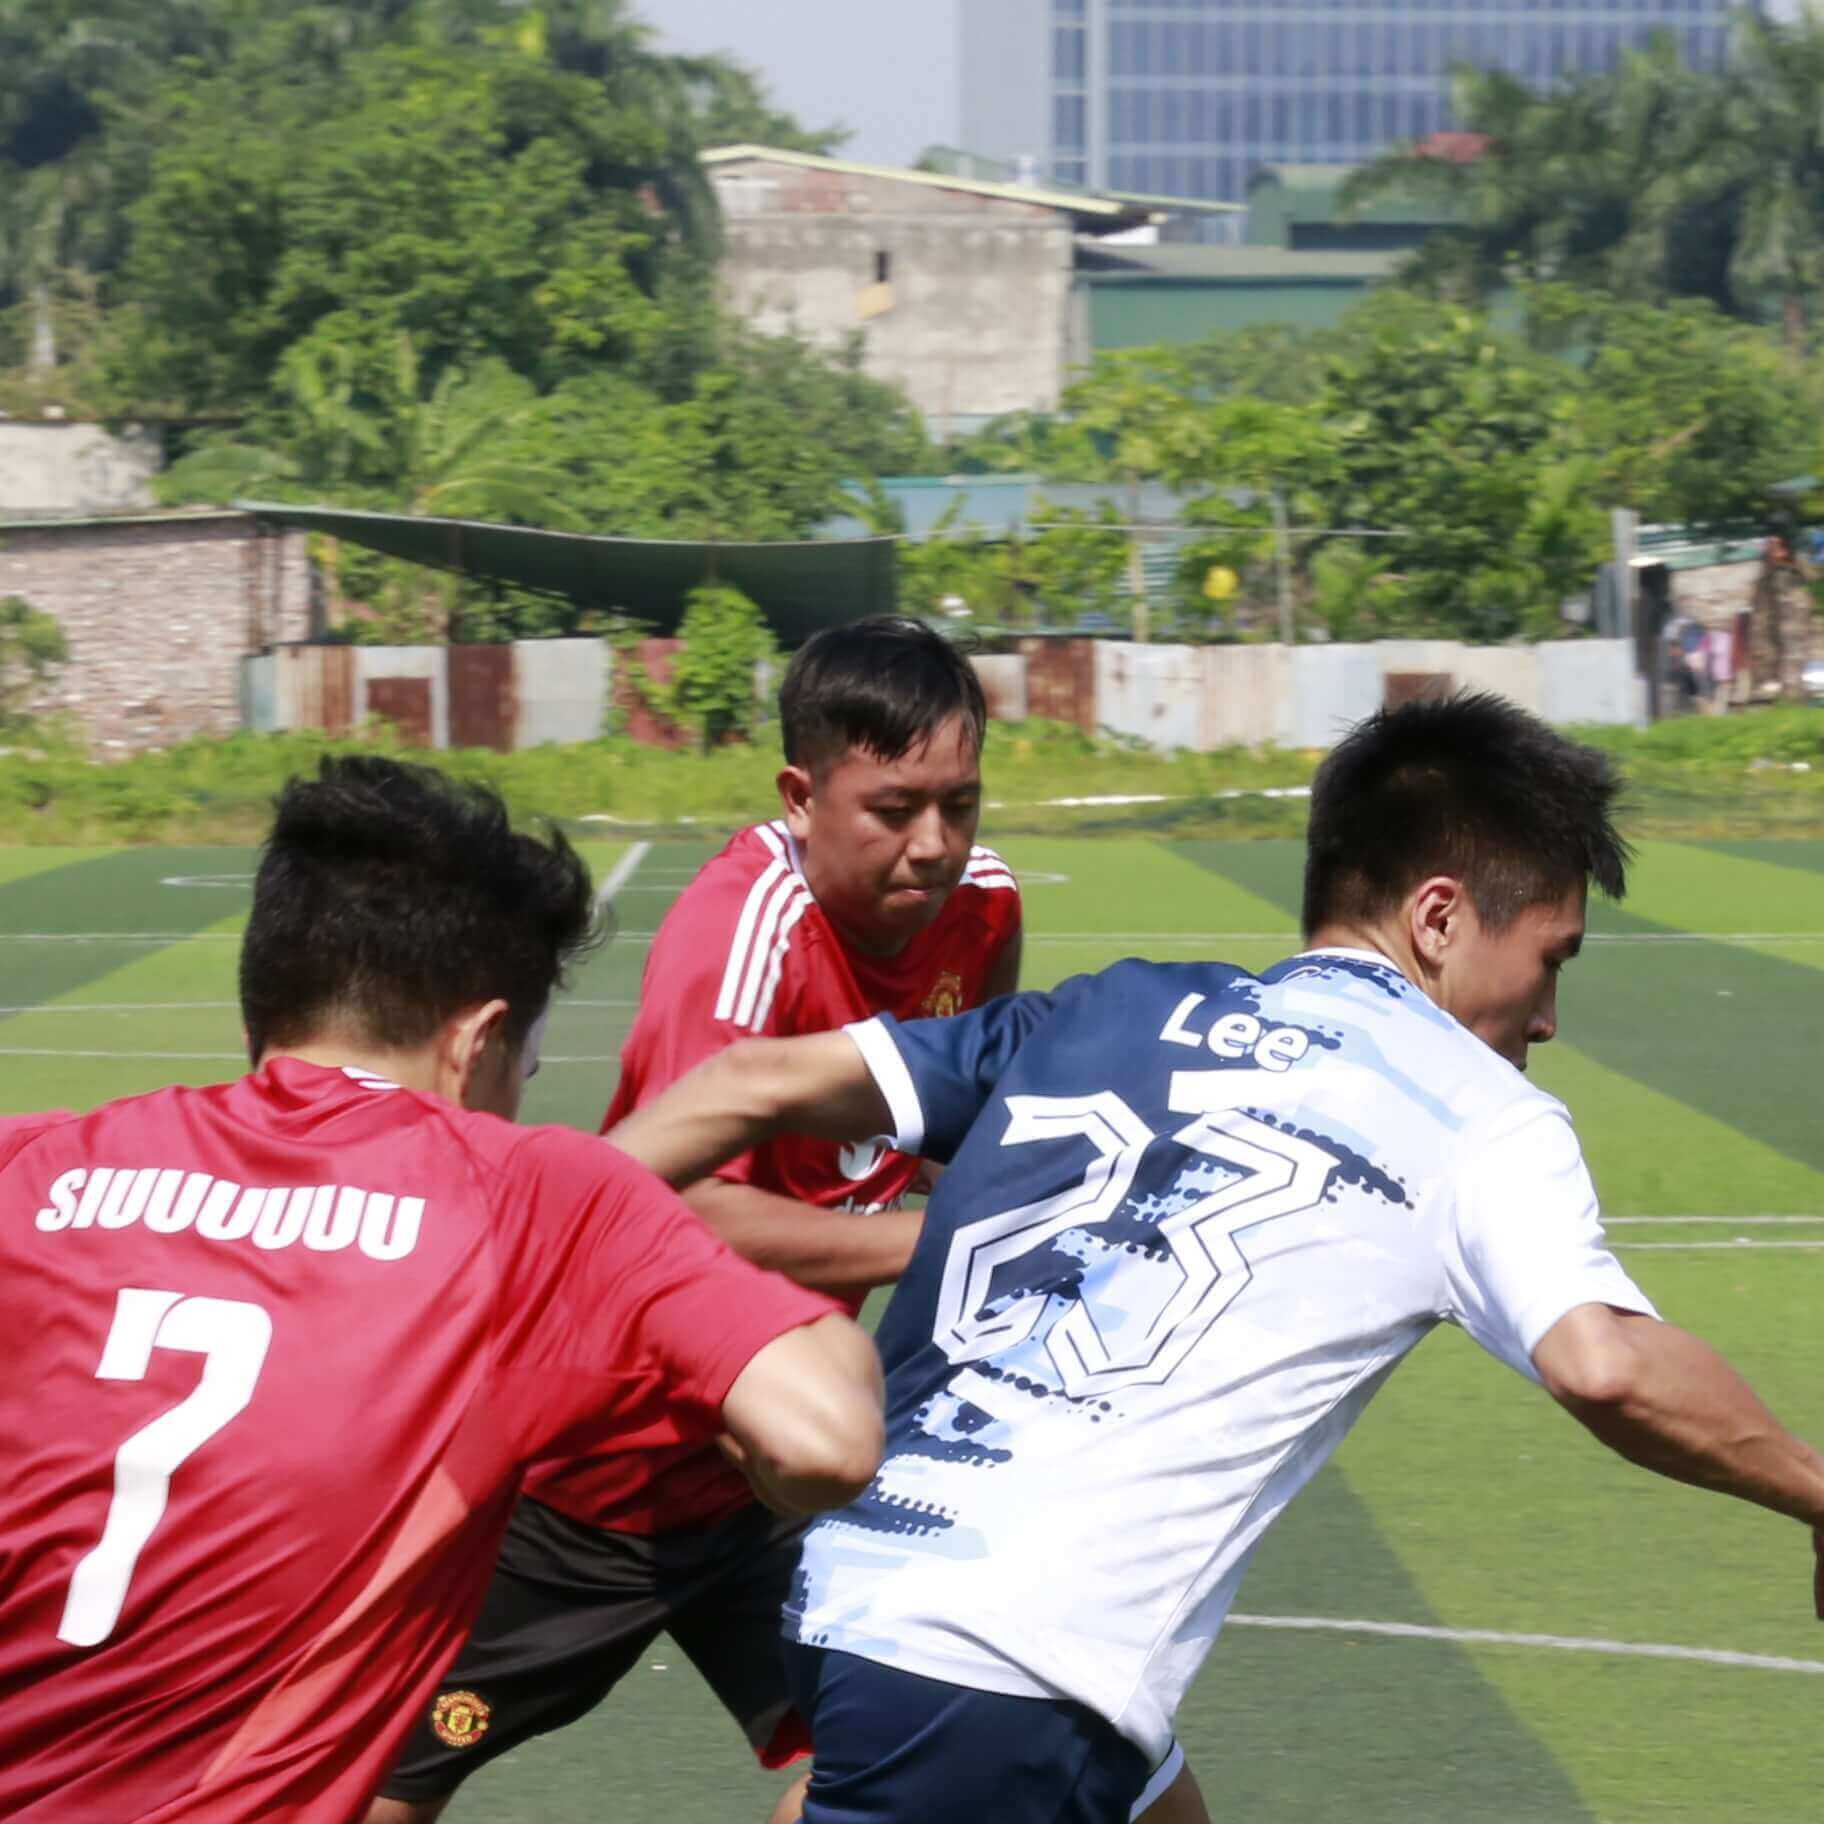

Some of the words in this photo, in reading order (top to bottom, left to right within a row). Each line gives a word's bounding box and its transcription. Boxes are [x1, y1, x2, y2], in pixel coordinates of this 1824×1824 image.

[1159, 992, 1310, 1072] Lee
[34, 1168, 426, 1261] SIUUUUUU
[932, 1089, 1341, 1398] 23
[56, 1287, 272, 1647] 7
